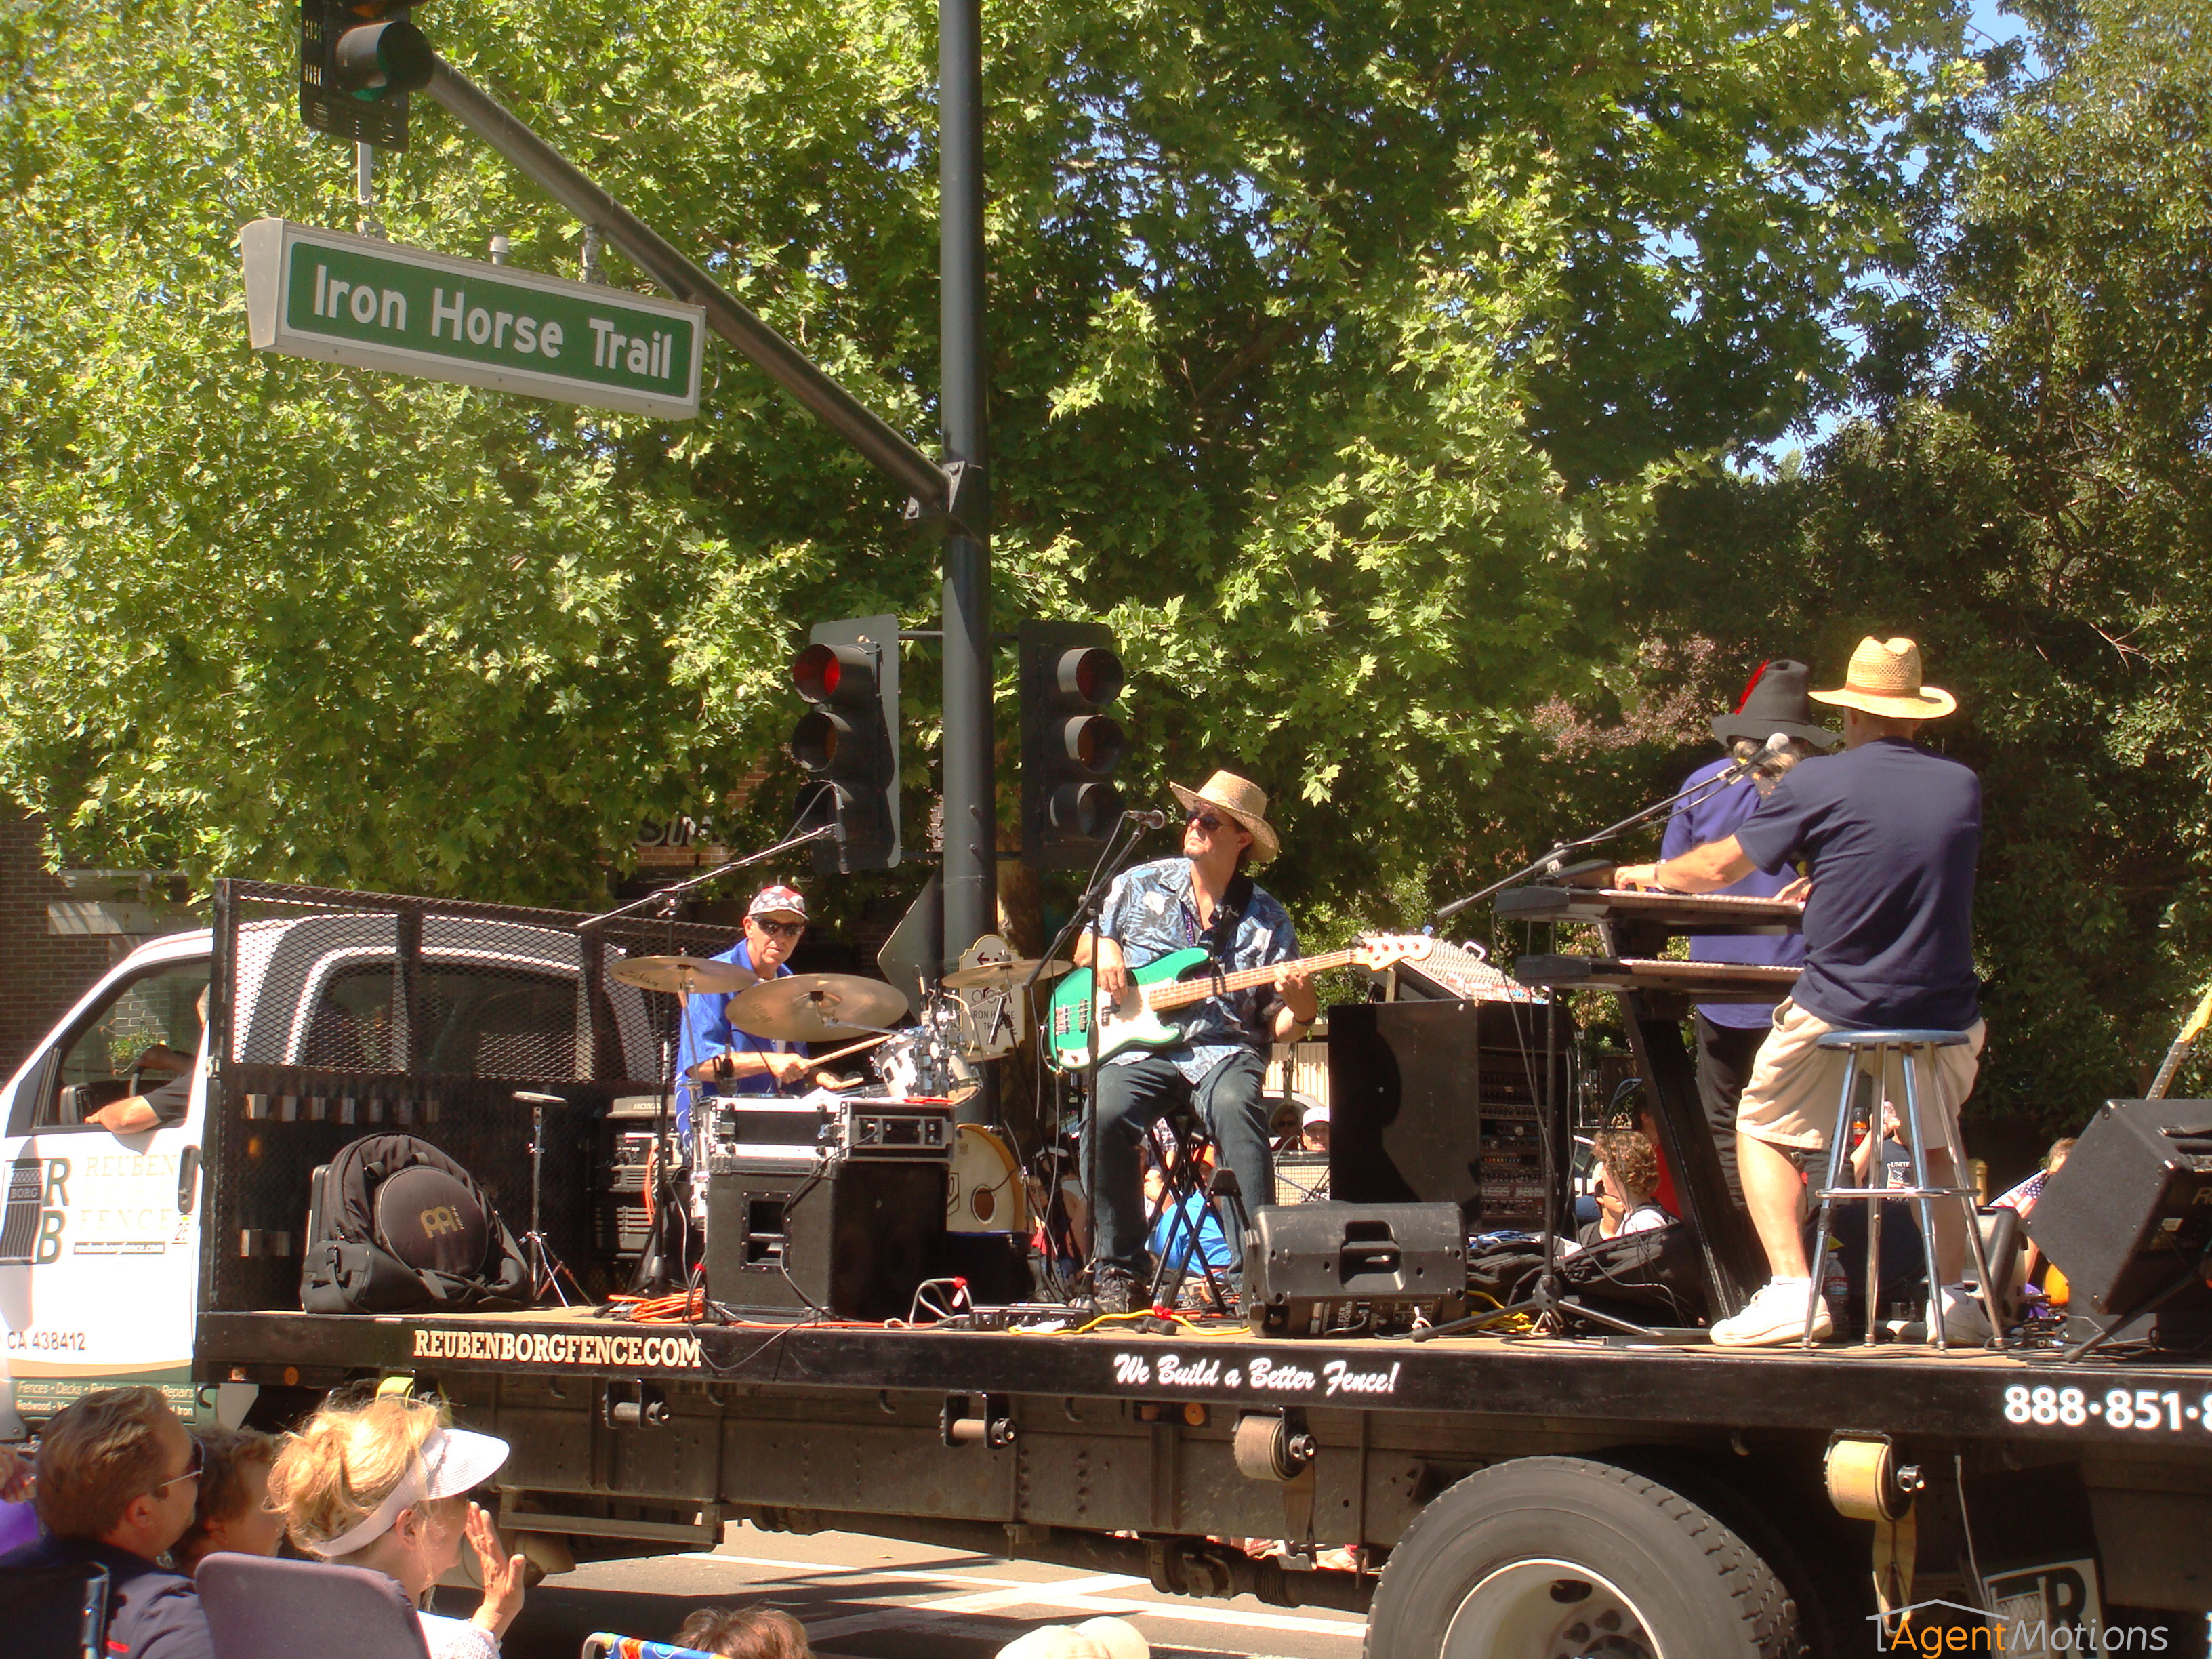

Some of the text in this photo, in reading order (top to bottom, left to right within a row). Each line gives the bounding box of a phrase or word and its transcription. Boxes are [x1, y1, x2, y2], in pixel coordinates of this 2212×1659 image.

[314, 264, 672, 380] Iron Horse Trail
[85, 1154, 178, 1177] REUBEN
[9, 1187, 39, 1200] BORG
[79, 1208, 173, 1231] FENCE
[75, 1242, 165, 1255] reubenborgfence.com
[8, 1330, 86, 1351] CA 438412
[413, 1329, 703, 1368] REUBENBORGFENCE.COM
[1113, 1353, 1401, 1396] We Build a Better Fence!
[18, 1380, 49, 1395] Fences
[56, 1382, 83, 1395] Decks
[161, 1385, 194, 1399] Repairs
[16, 1399, 52, 1411] Redwood
[176, 1405, 194, 1416] Iron
